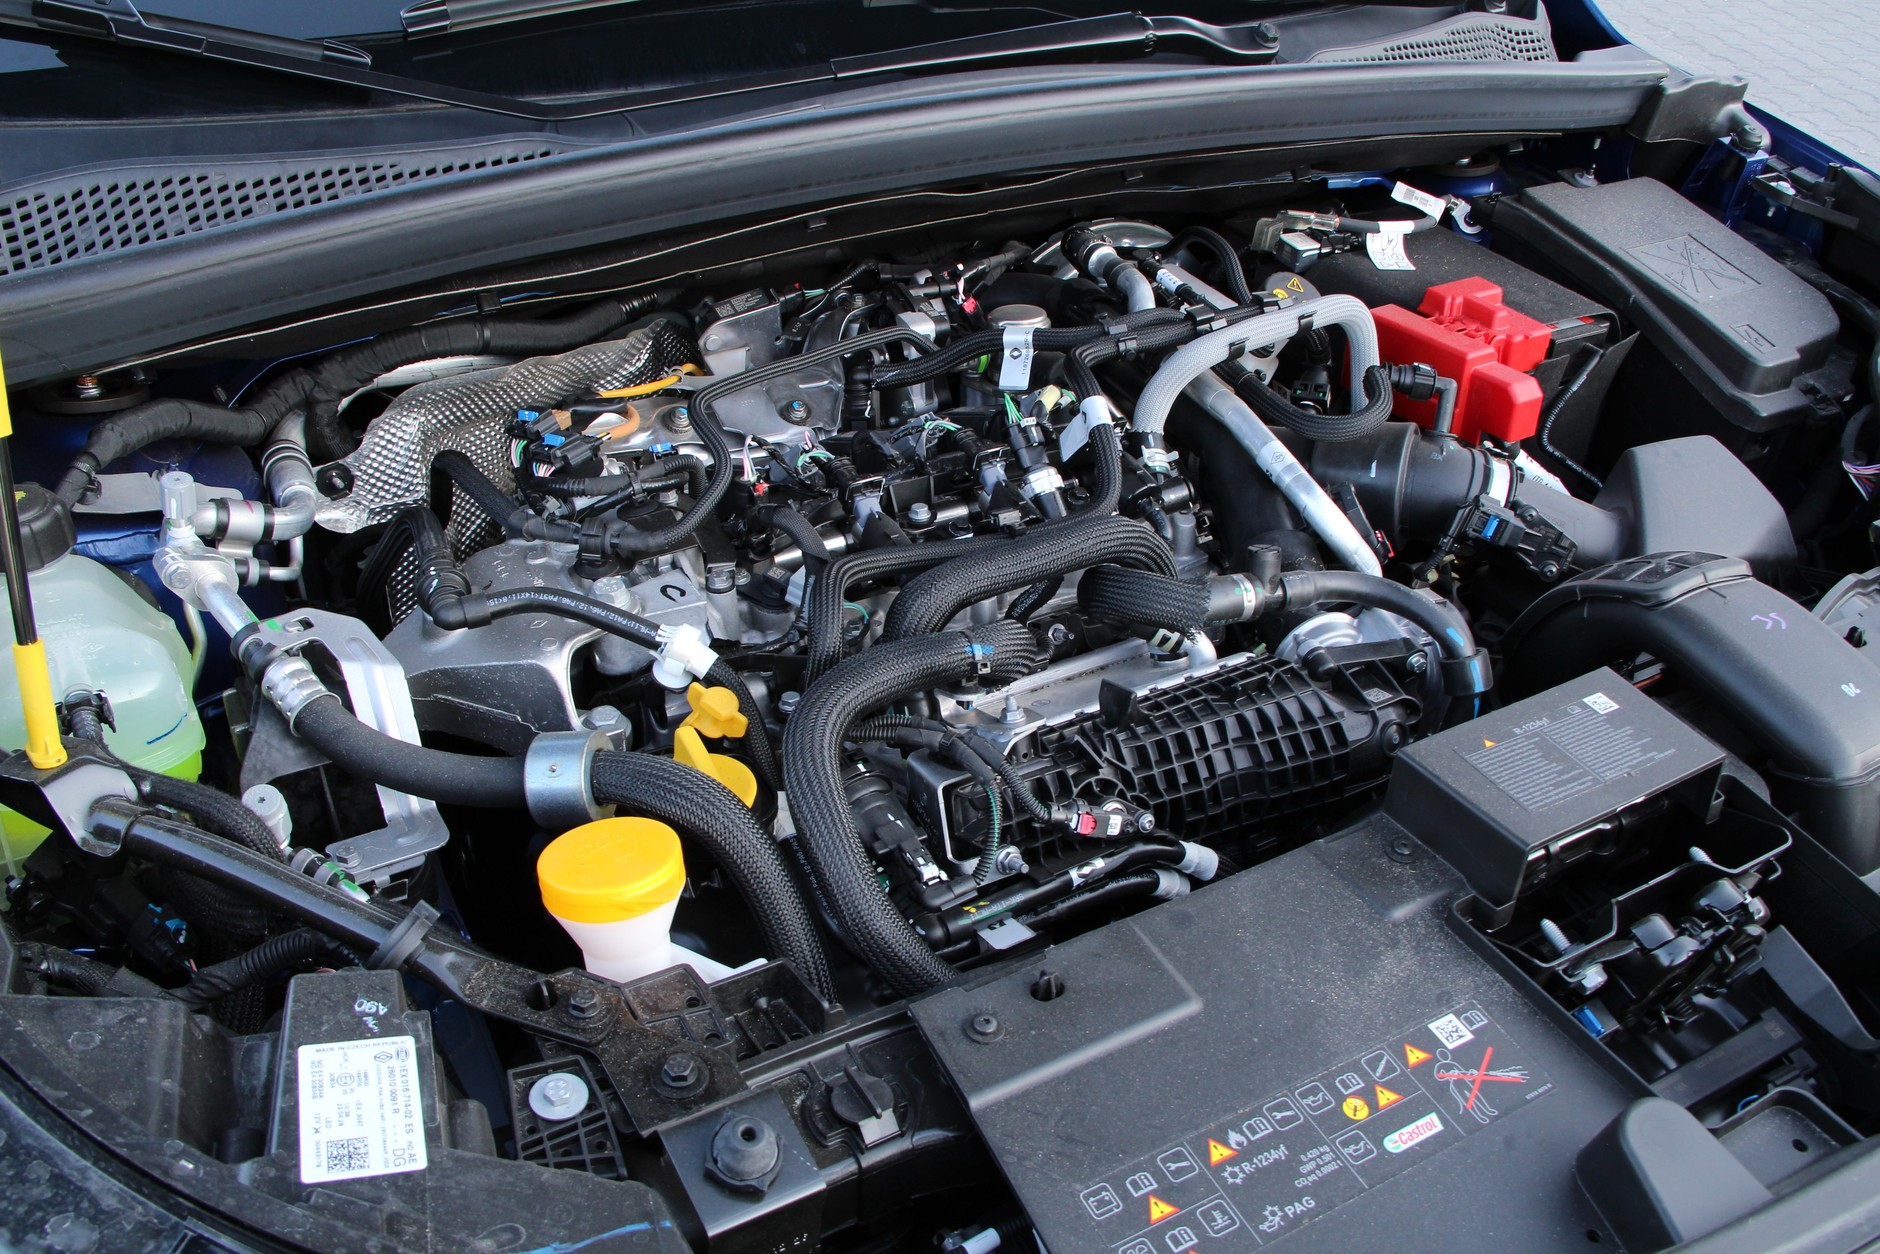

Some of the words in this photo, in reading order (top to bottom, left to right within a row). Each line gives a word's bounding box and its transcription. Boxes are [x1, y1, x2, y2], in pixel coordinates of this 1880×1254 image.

[399, 1064, 408, 1078] 1EX
[404, 1122, 413, 1134] ES
[1398, 1116, 1439, 1146] Castrol
[393, 1148, 407, 1167] DG
[408, 1152, 417, 1164] AE
[1240, 1143, 1289, 1175] R-1234yf
[1300, 1148, 1320, 1162] 0.420
[1318, 1144, 1331, 1154] kg
[1299, 1160, 1317, 1174] GWP
[1315, 1152, 1336, 1165] 0.501
[1315, 1161, 1340, 1178] 0.0002
[1284, 1196, 1316, 1218] PAG
